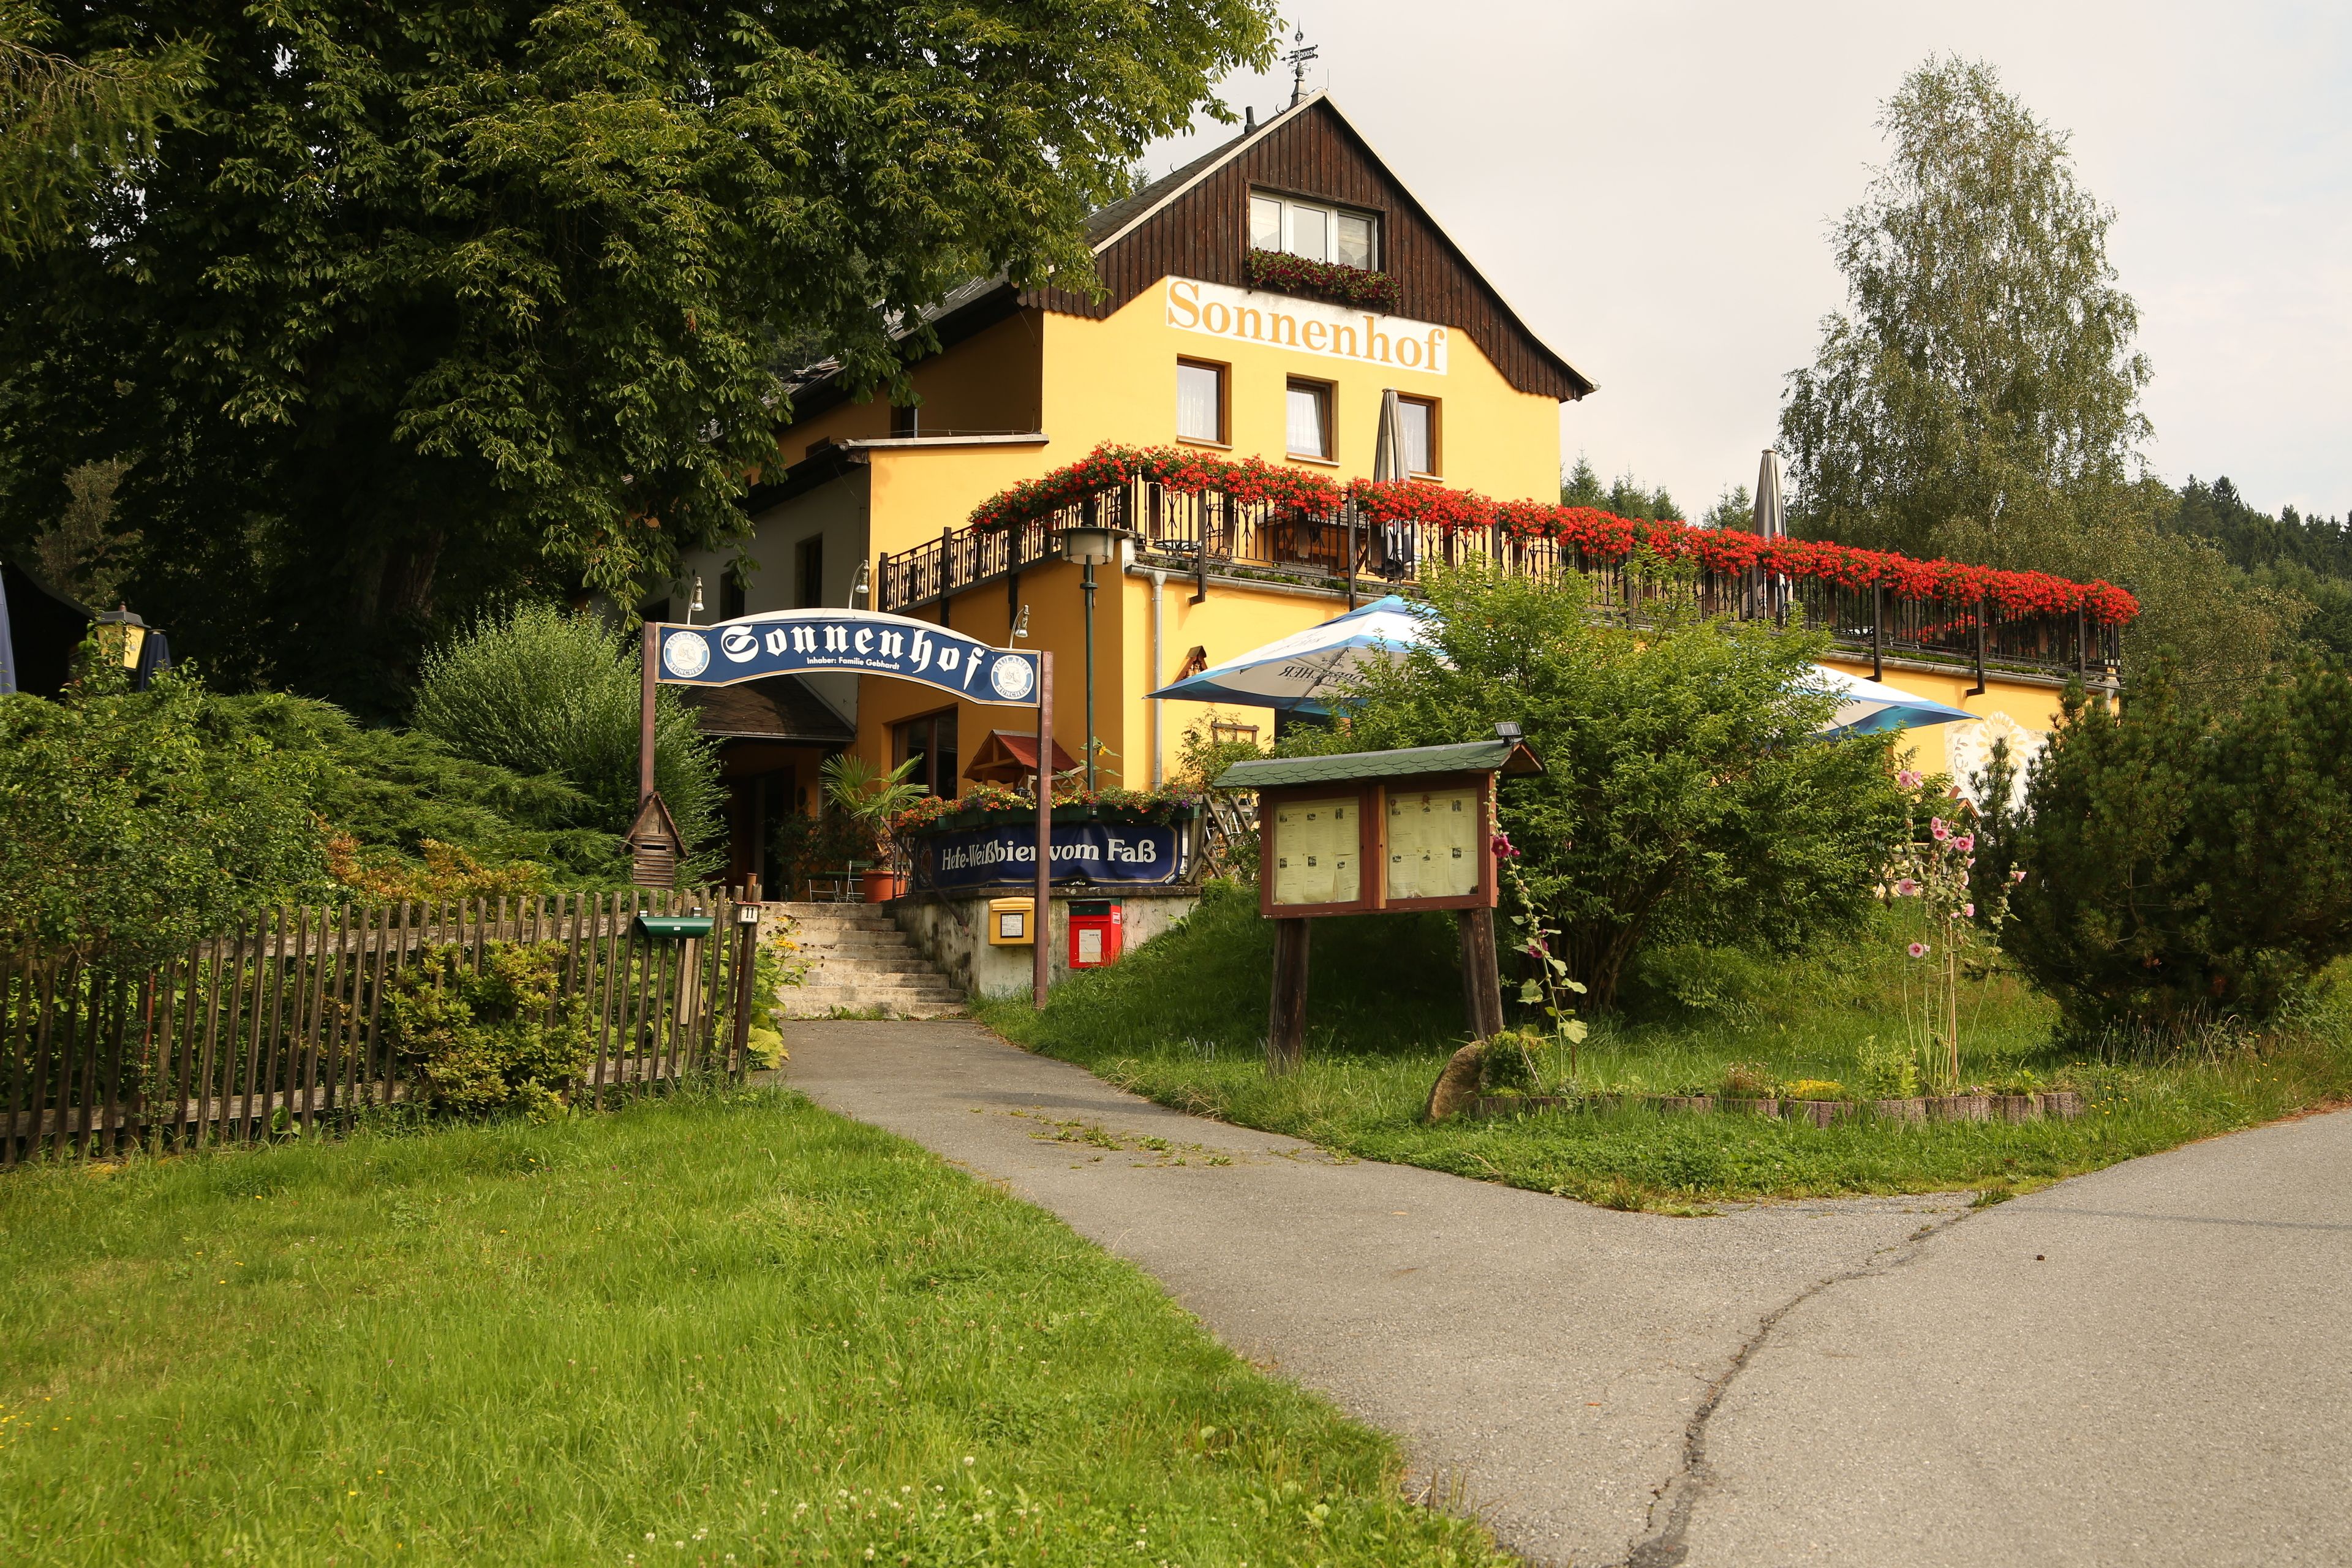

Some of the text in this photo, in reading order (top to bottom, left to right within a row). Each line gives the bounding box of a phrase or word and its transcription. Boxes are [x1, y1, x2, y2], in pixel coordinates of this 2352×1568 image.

[1300, 50, 1313, 58] 2003
[1167, 281, 1445, 371] Sonnenhof
[666, 633, 707, 651] PAULANER
[720, 624, 986, 690] Sonnenhof
[807, 656, 900, 670] Inhaber: Familie Gebhardt
[993, 657, 1031, 675] PAULANER
[942, 840, 1036, 870] Hefe-Weißbier
[1049, 843, 1099, 861] vom
[1107, 838, 1156, 862] Faß
[745, 907, 754, 919] 11
